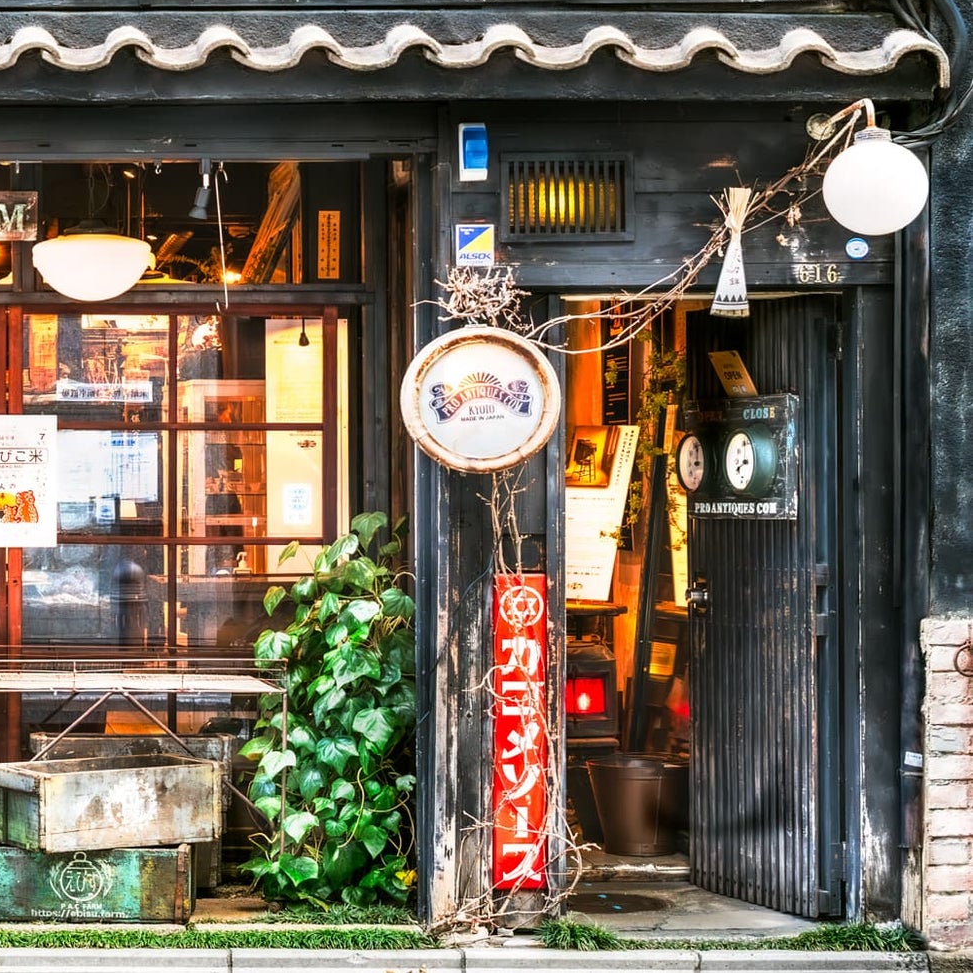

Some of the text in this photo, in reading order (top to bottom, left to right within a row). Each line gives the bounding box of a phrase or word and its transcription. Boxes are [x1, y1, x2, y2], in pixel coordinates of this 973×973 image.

[798, 263, 839, 284] 616
[724, 371, 742, 380] OPEN
[442, 399, 460, 417] PRO
[460, 386, 504, 402] ANTIQUES
[469, 404, 495, 415] KYOTO
[742, 406, 776, 420] CLOSE
[756, 502, 778, 514] COM
